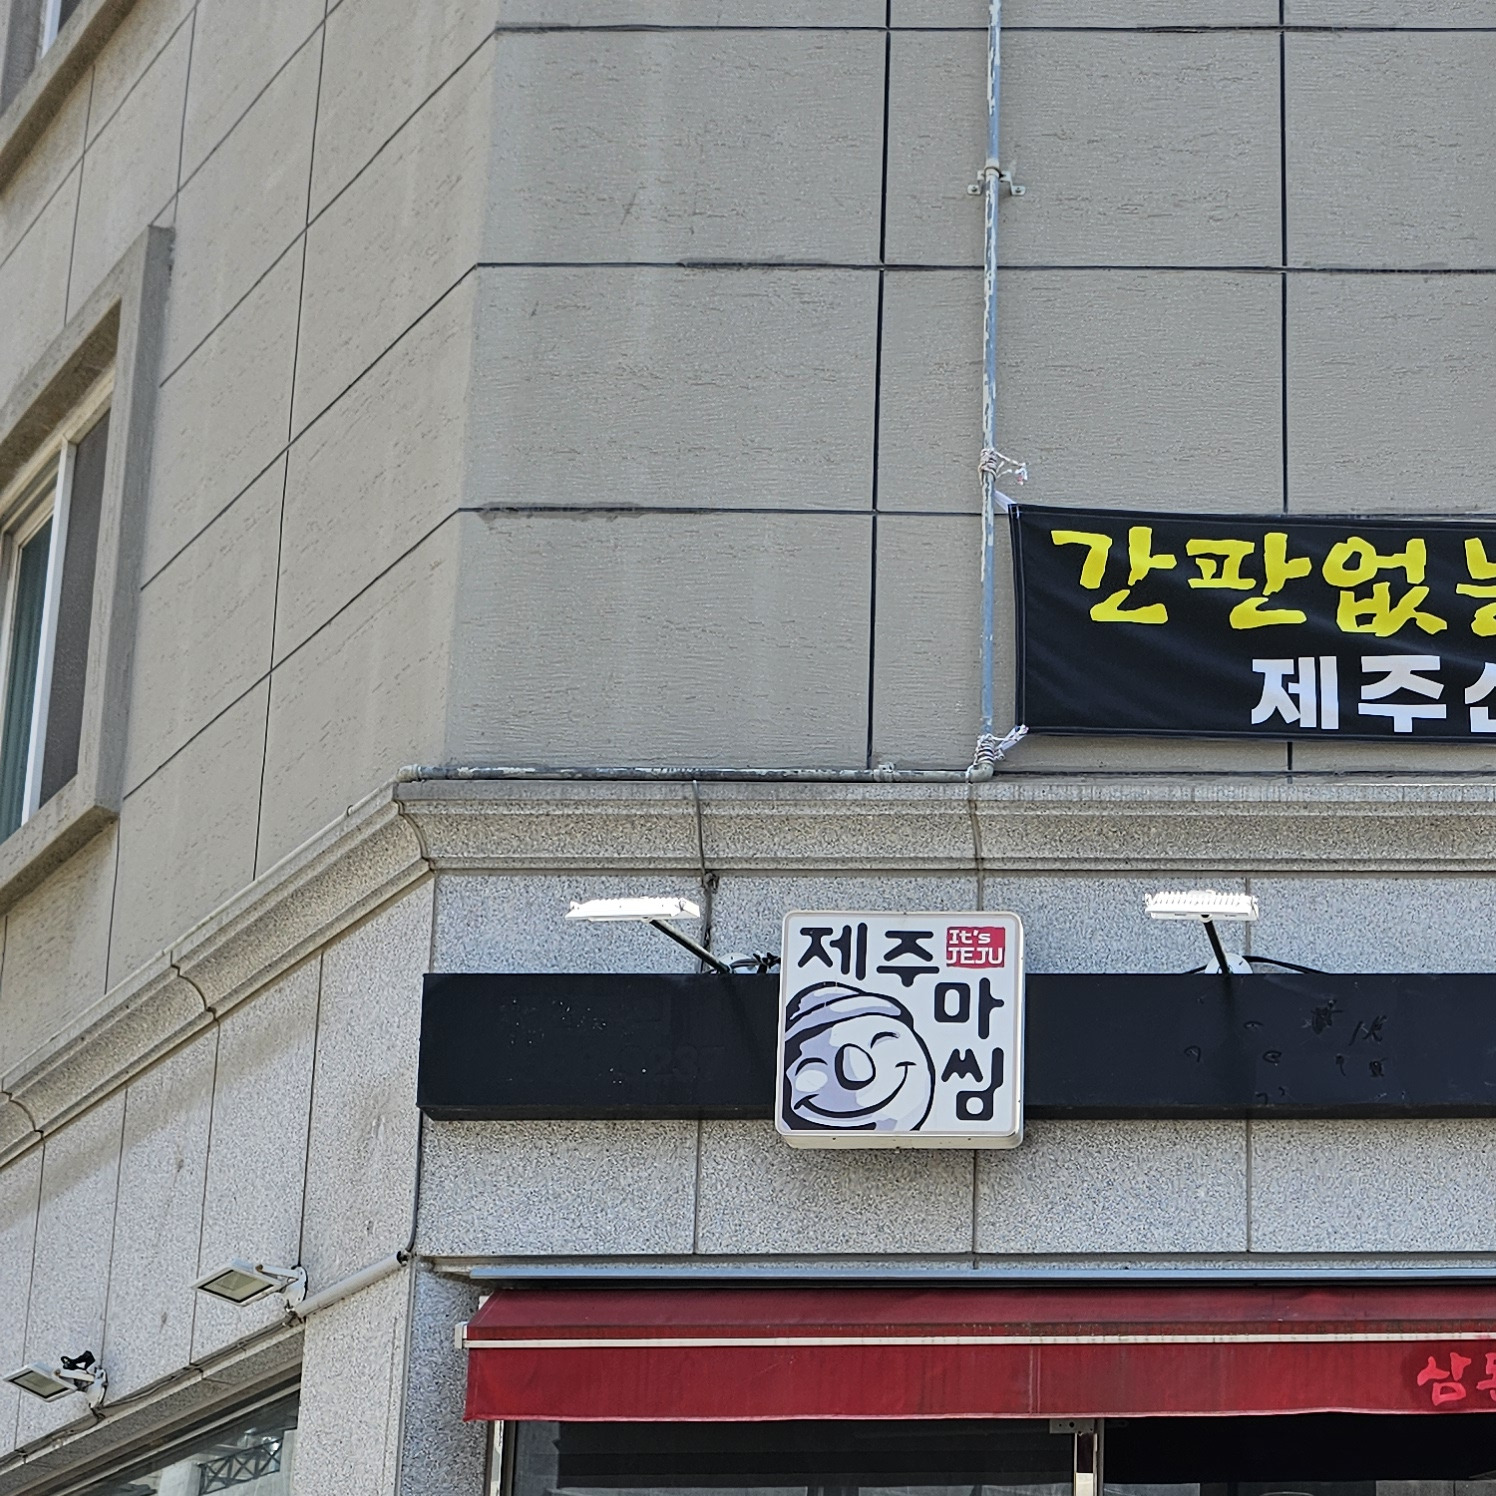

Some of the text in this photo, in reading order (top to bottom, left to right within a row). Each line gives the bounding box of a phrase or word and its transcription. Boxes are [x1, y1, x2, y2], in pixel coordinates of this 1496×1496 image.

[948, 929, 991, 945] It's
[797, 922, 940, 988] 제주
[946, 947, 1003, 965] JEJU
